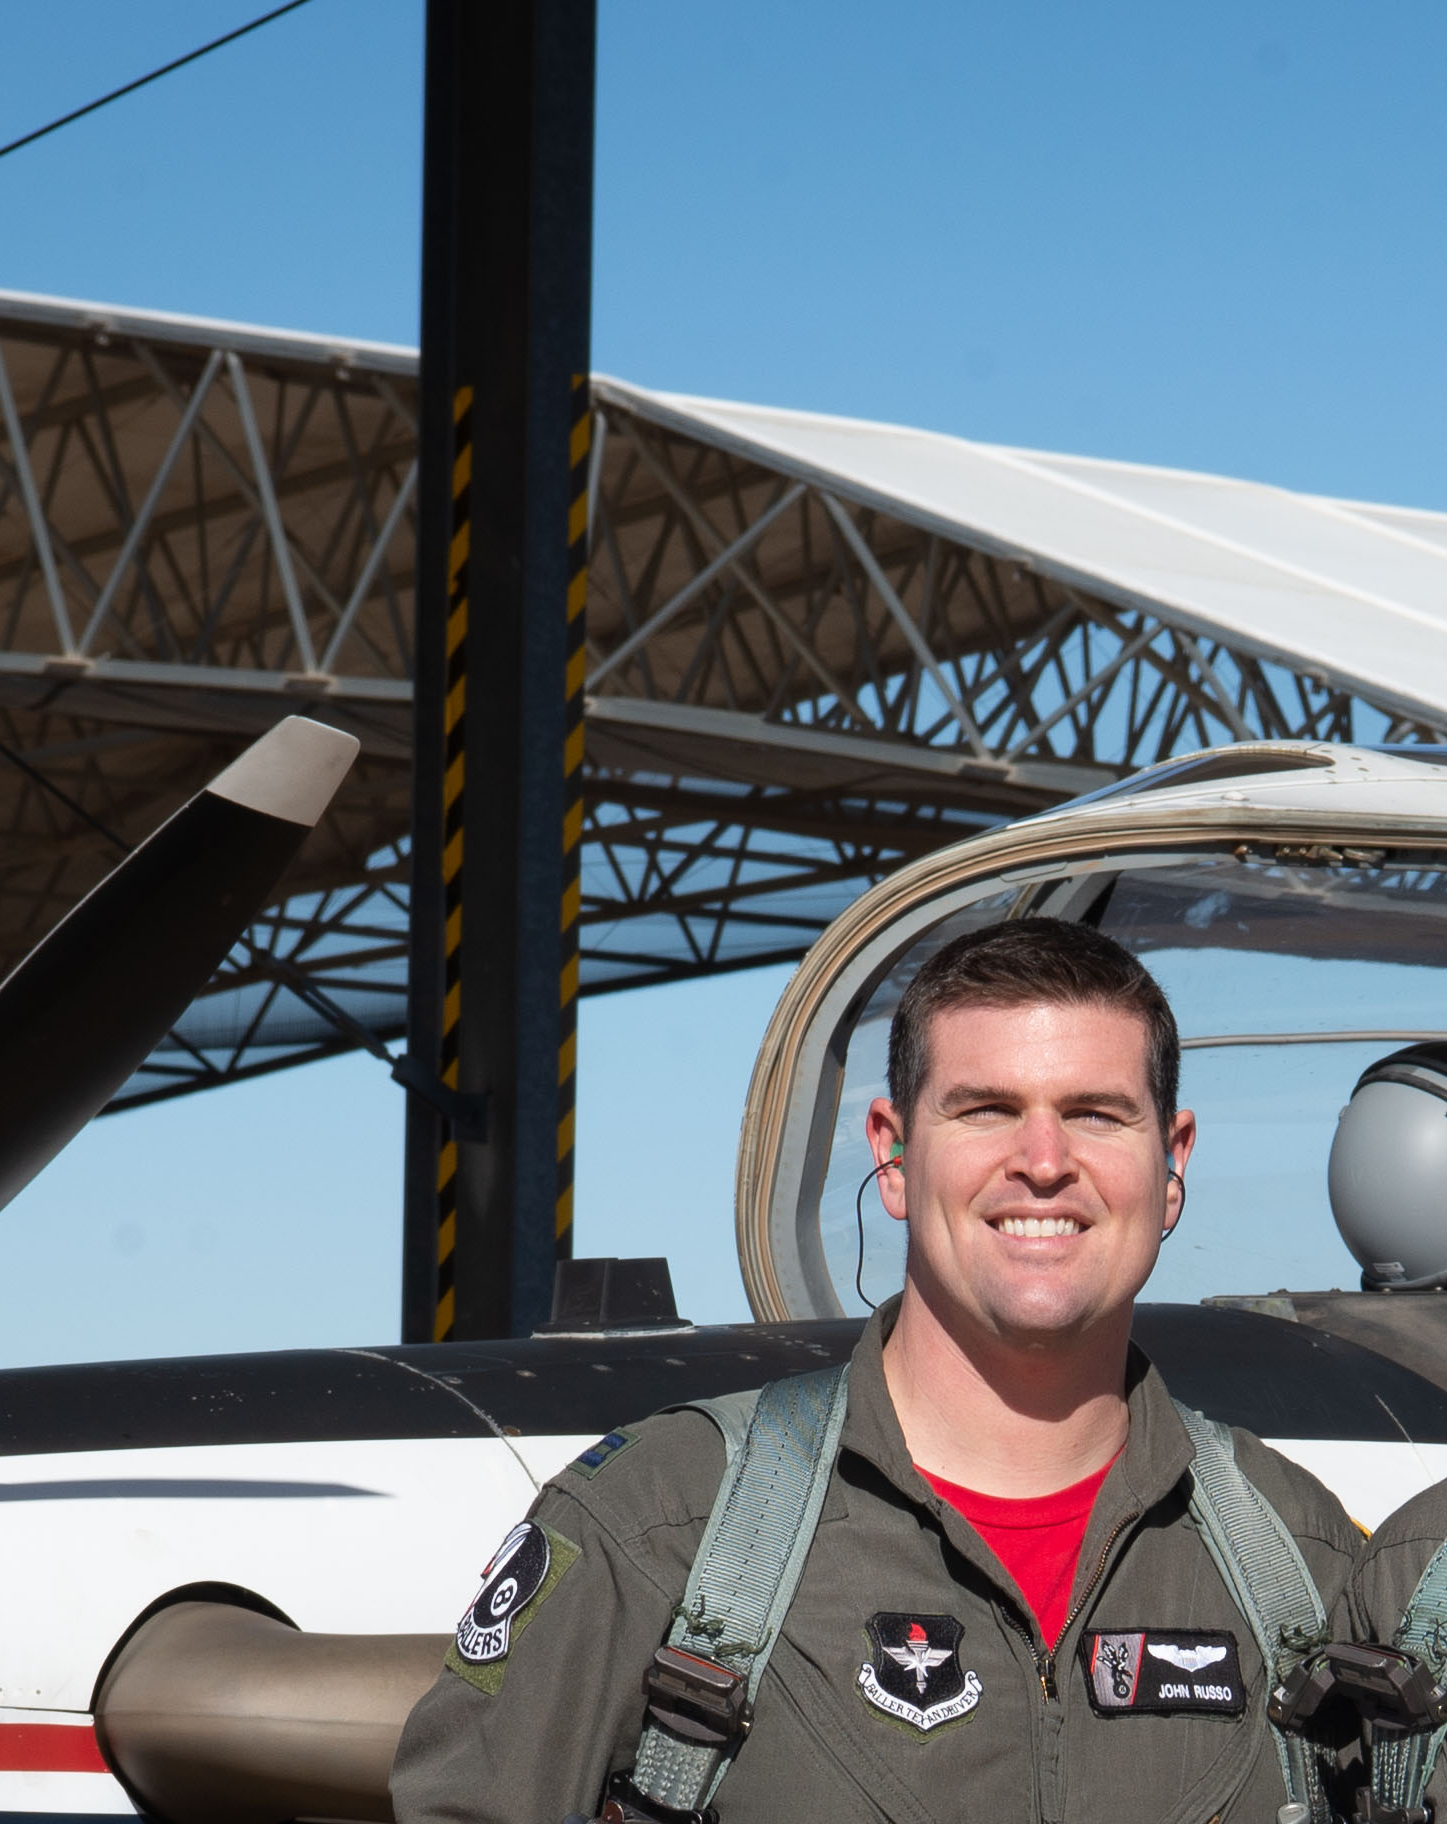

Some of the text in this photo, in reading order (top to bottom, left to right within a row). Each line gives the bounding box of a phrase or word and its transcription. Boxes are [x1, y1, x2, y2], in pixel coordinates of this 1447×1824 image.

[865, 1683, 905, 1715] BALLER
[941, 1689, 978, 1717] DRIVER
[1158, 1683, 1232, 1701] JOHN RUSSO
